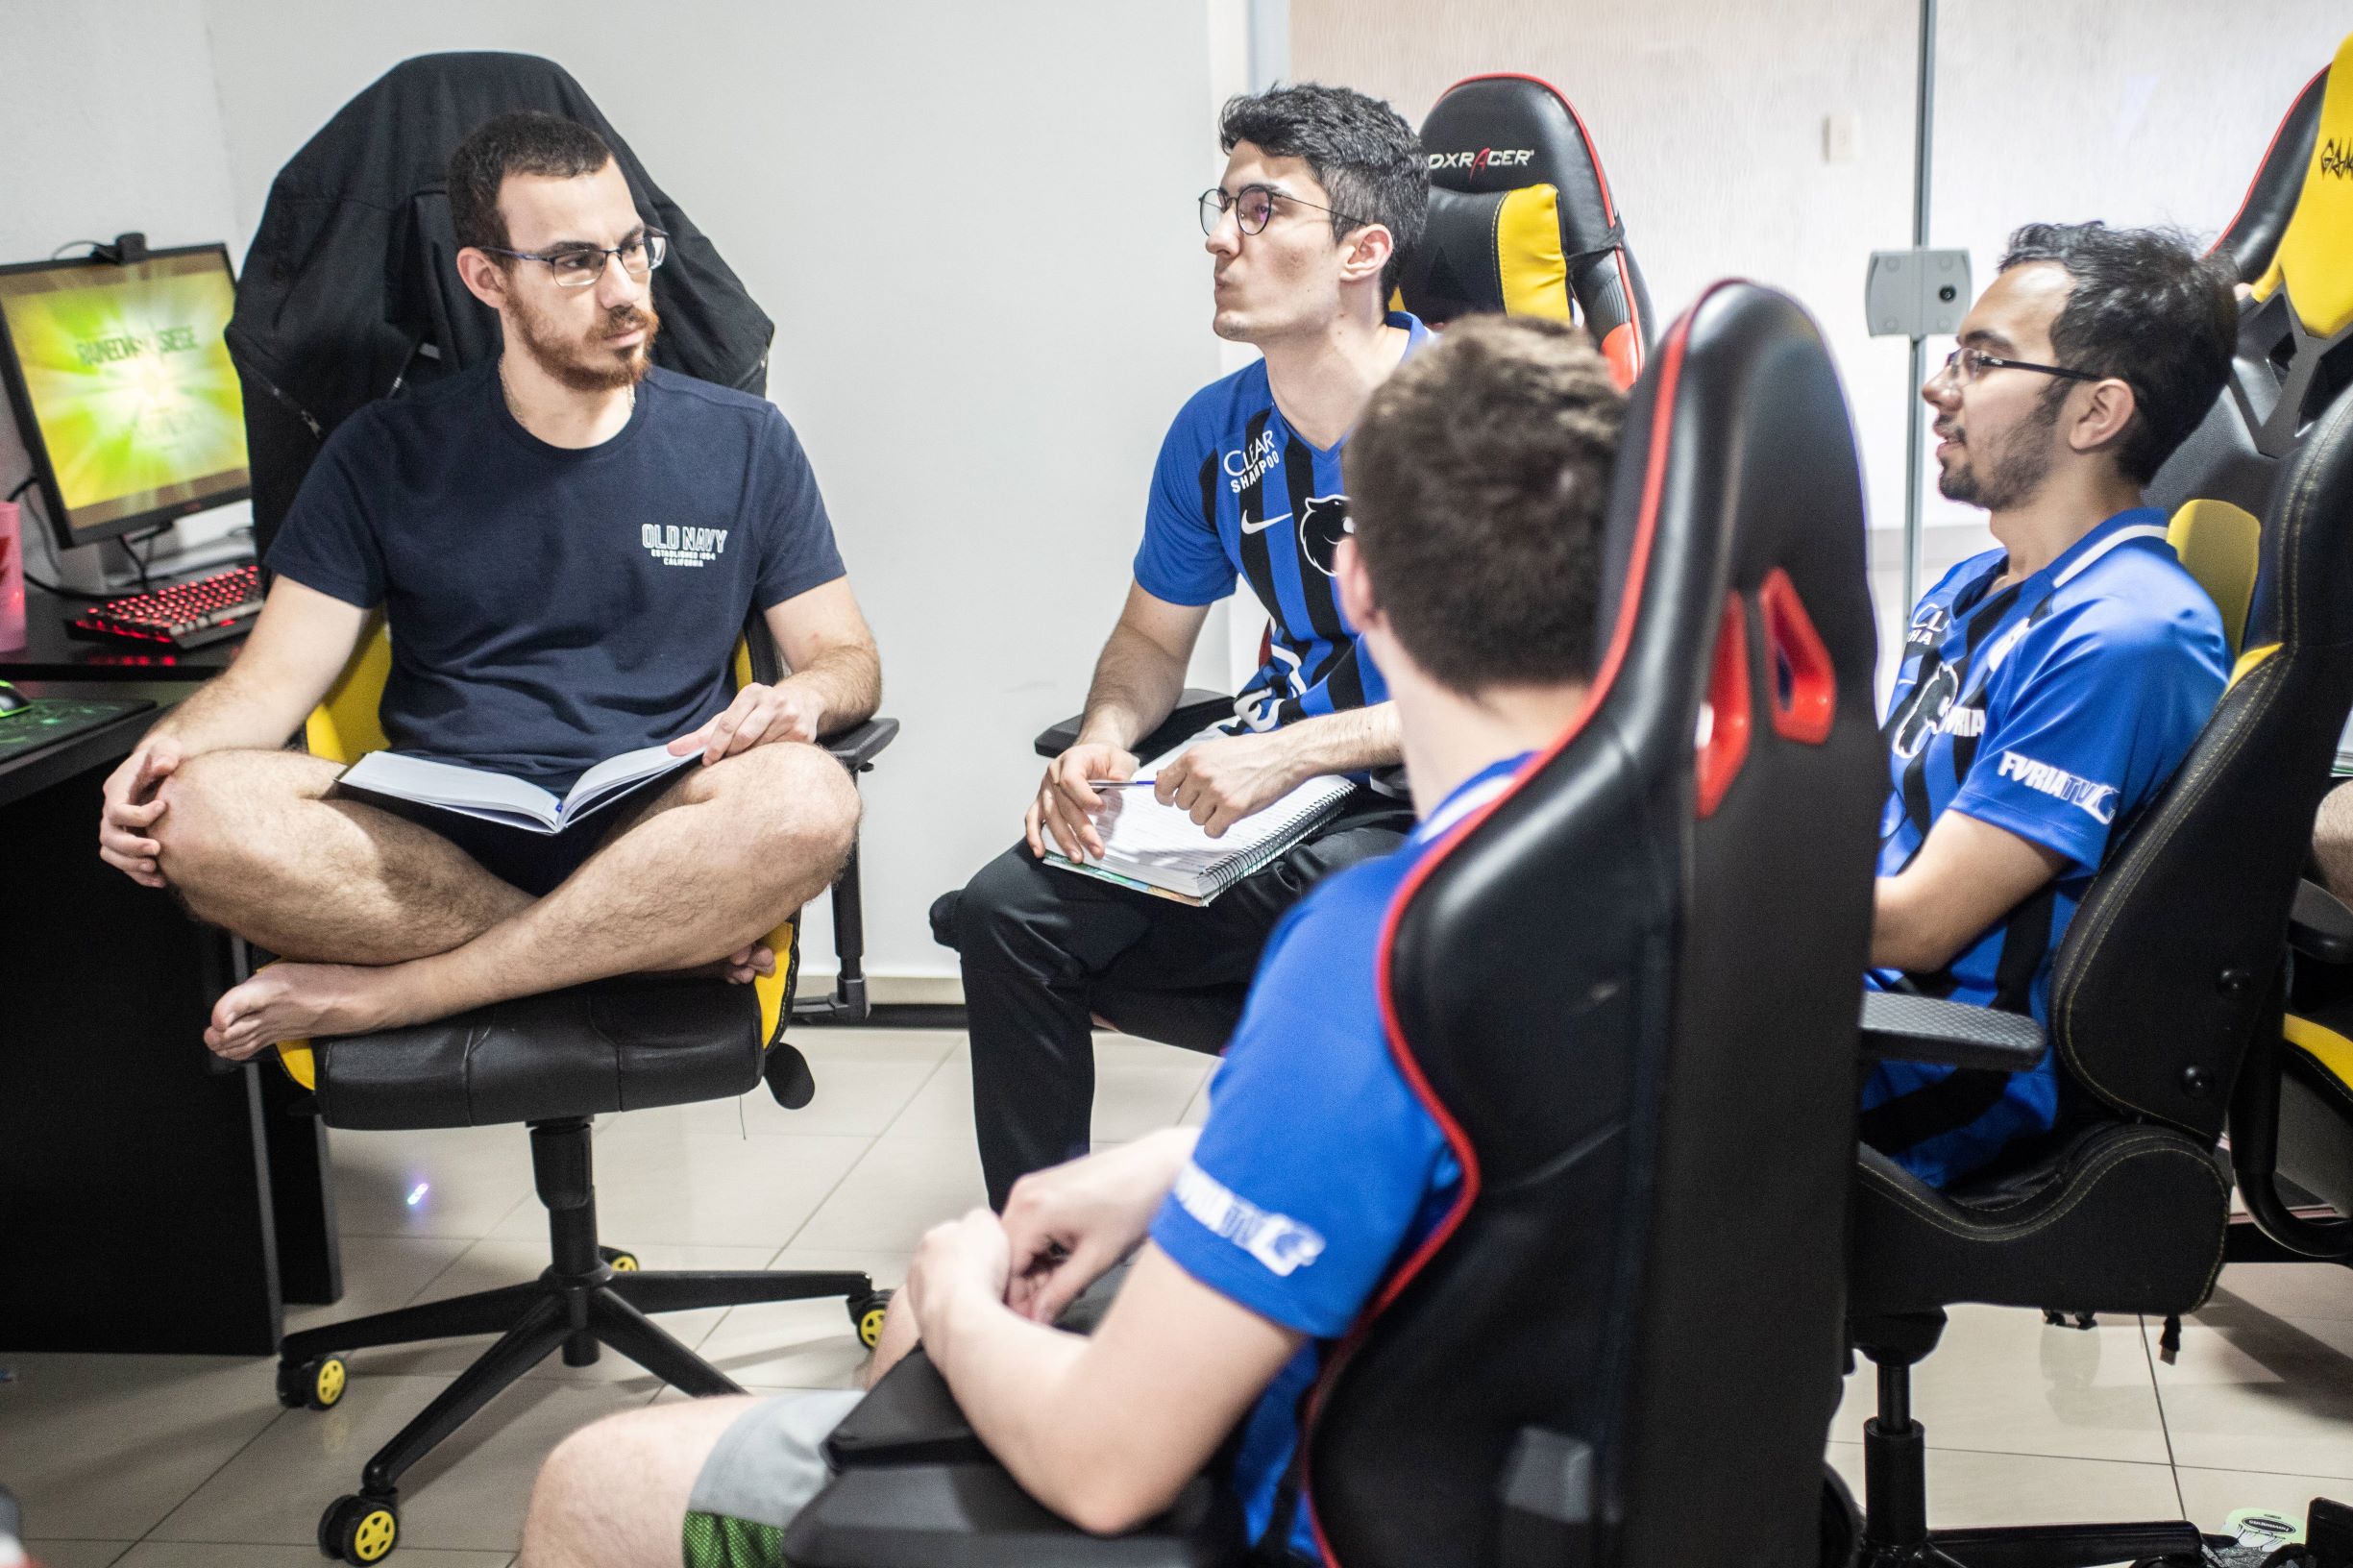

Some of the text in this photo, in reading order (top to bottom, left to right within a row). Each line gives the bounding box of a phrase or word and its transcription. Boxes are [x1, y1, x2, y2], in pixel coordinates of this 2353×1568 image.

[1428, 147, 1532, 181] DXRACER
[1223, 430, 1275, 477] CLEAR
[1230, 451, 1280, 494] SHAMPOO
[642, 524, 728, 553] OLD NAVY
[663, 557, 703, 568] CALIFORNIA
